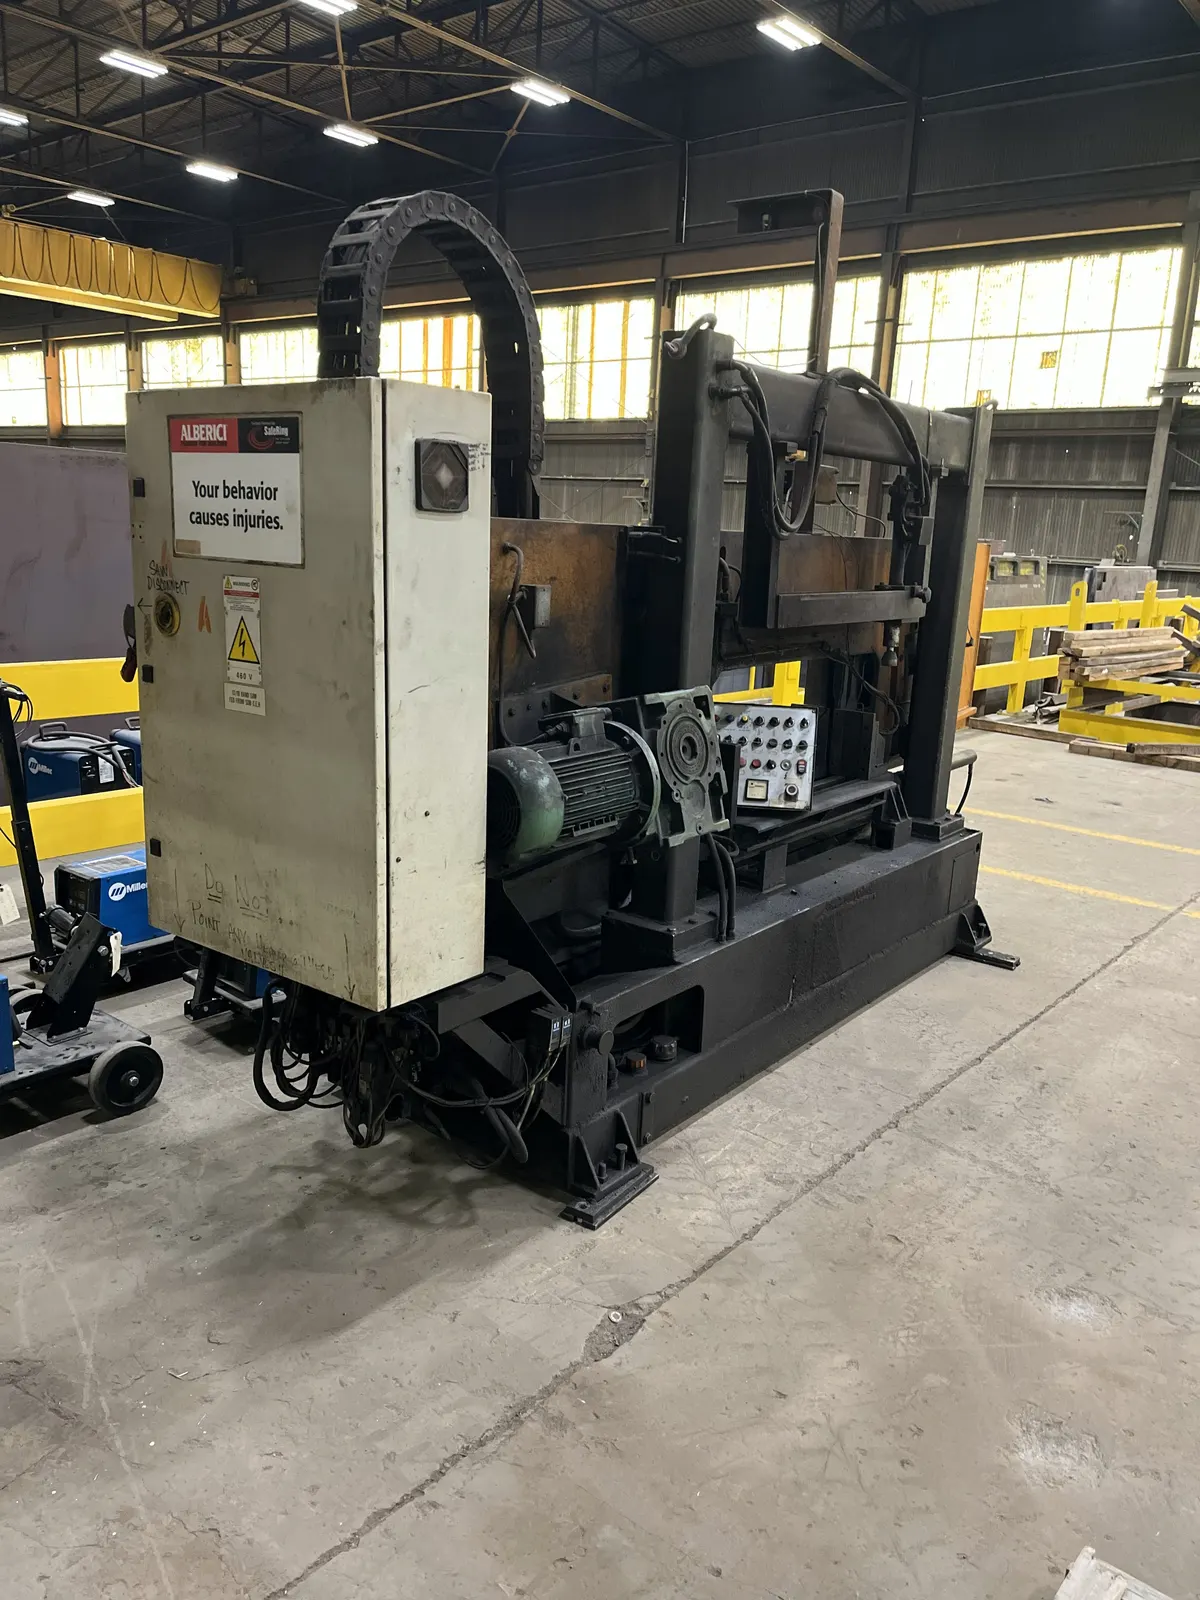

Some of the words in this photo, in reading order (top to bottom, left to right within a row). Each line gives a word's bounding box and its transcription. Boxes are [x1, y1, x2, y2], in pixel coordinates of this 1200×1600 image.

[181, 424, 227, 441] ALBERICI
[192, 480, 219, 498] Your
[223, 480, 278, 501] behavior
[189, 511, 229, 527] causes
[233, 508, 283, 533] injuries.
[149, 560, 168, 577] SAW
